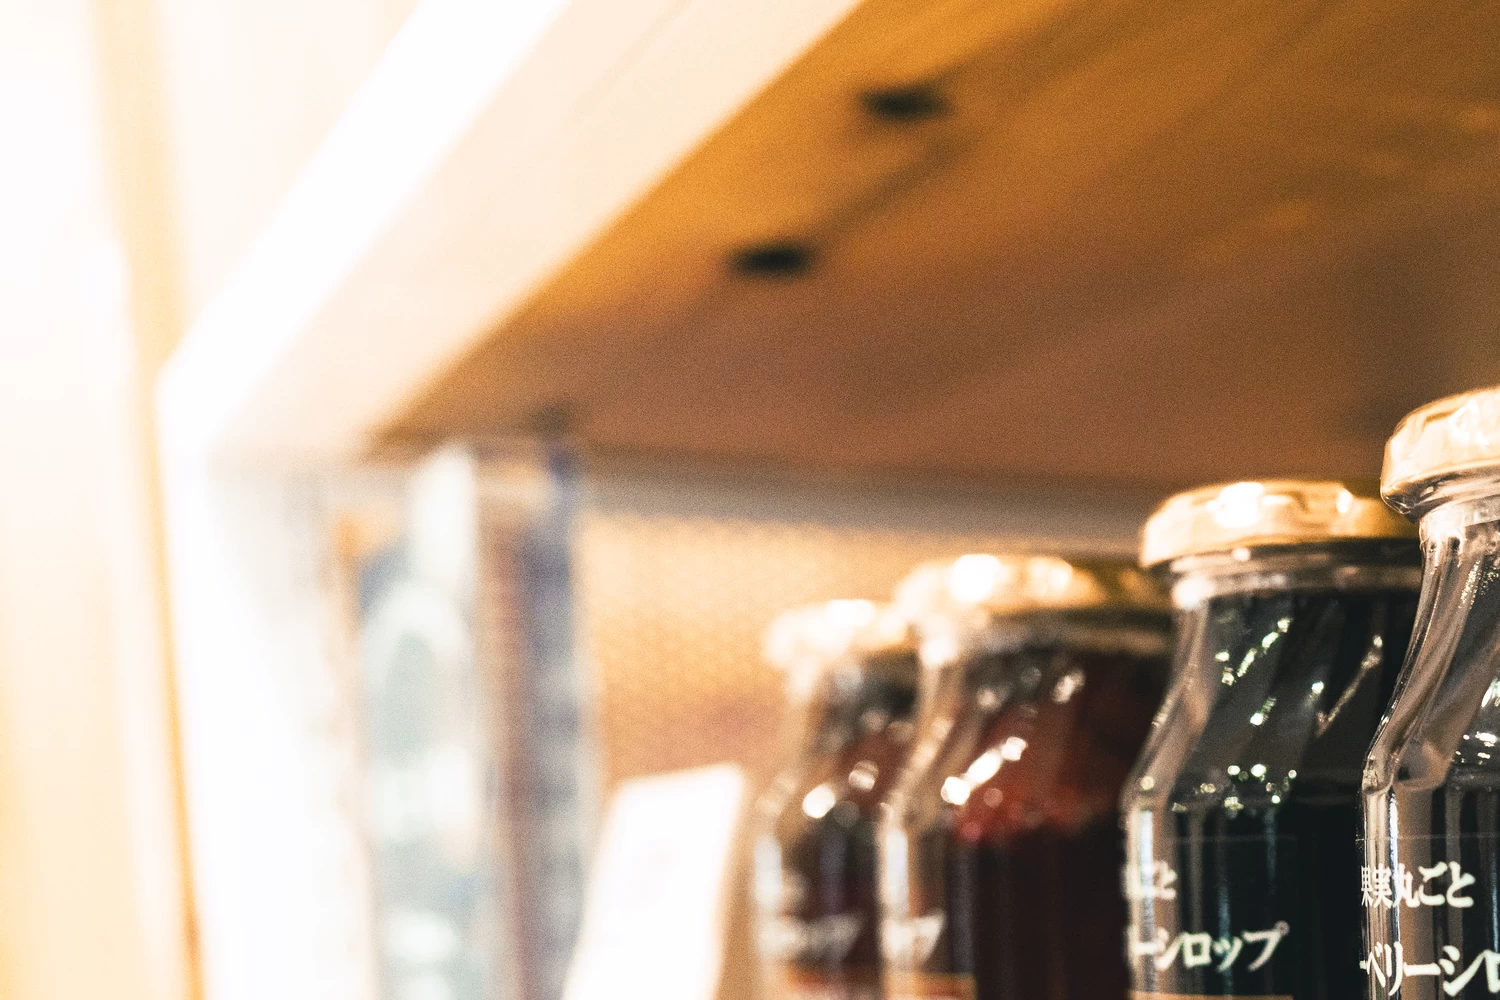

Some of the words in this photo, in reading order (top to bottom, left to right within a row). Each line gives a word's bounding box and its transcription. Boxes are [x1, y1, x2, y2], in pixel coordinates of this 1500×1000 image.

[1361, 861, 1476, 908] 果実丸ごと
